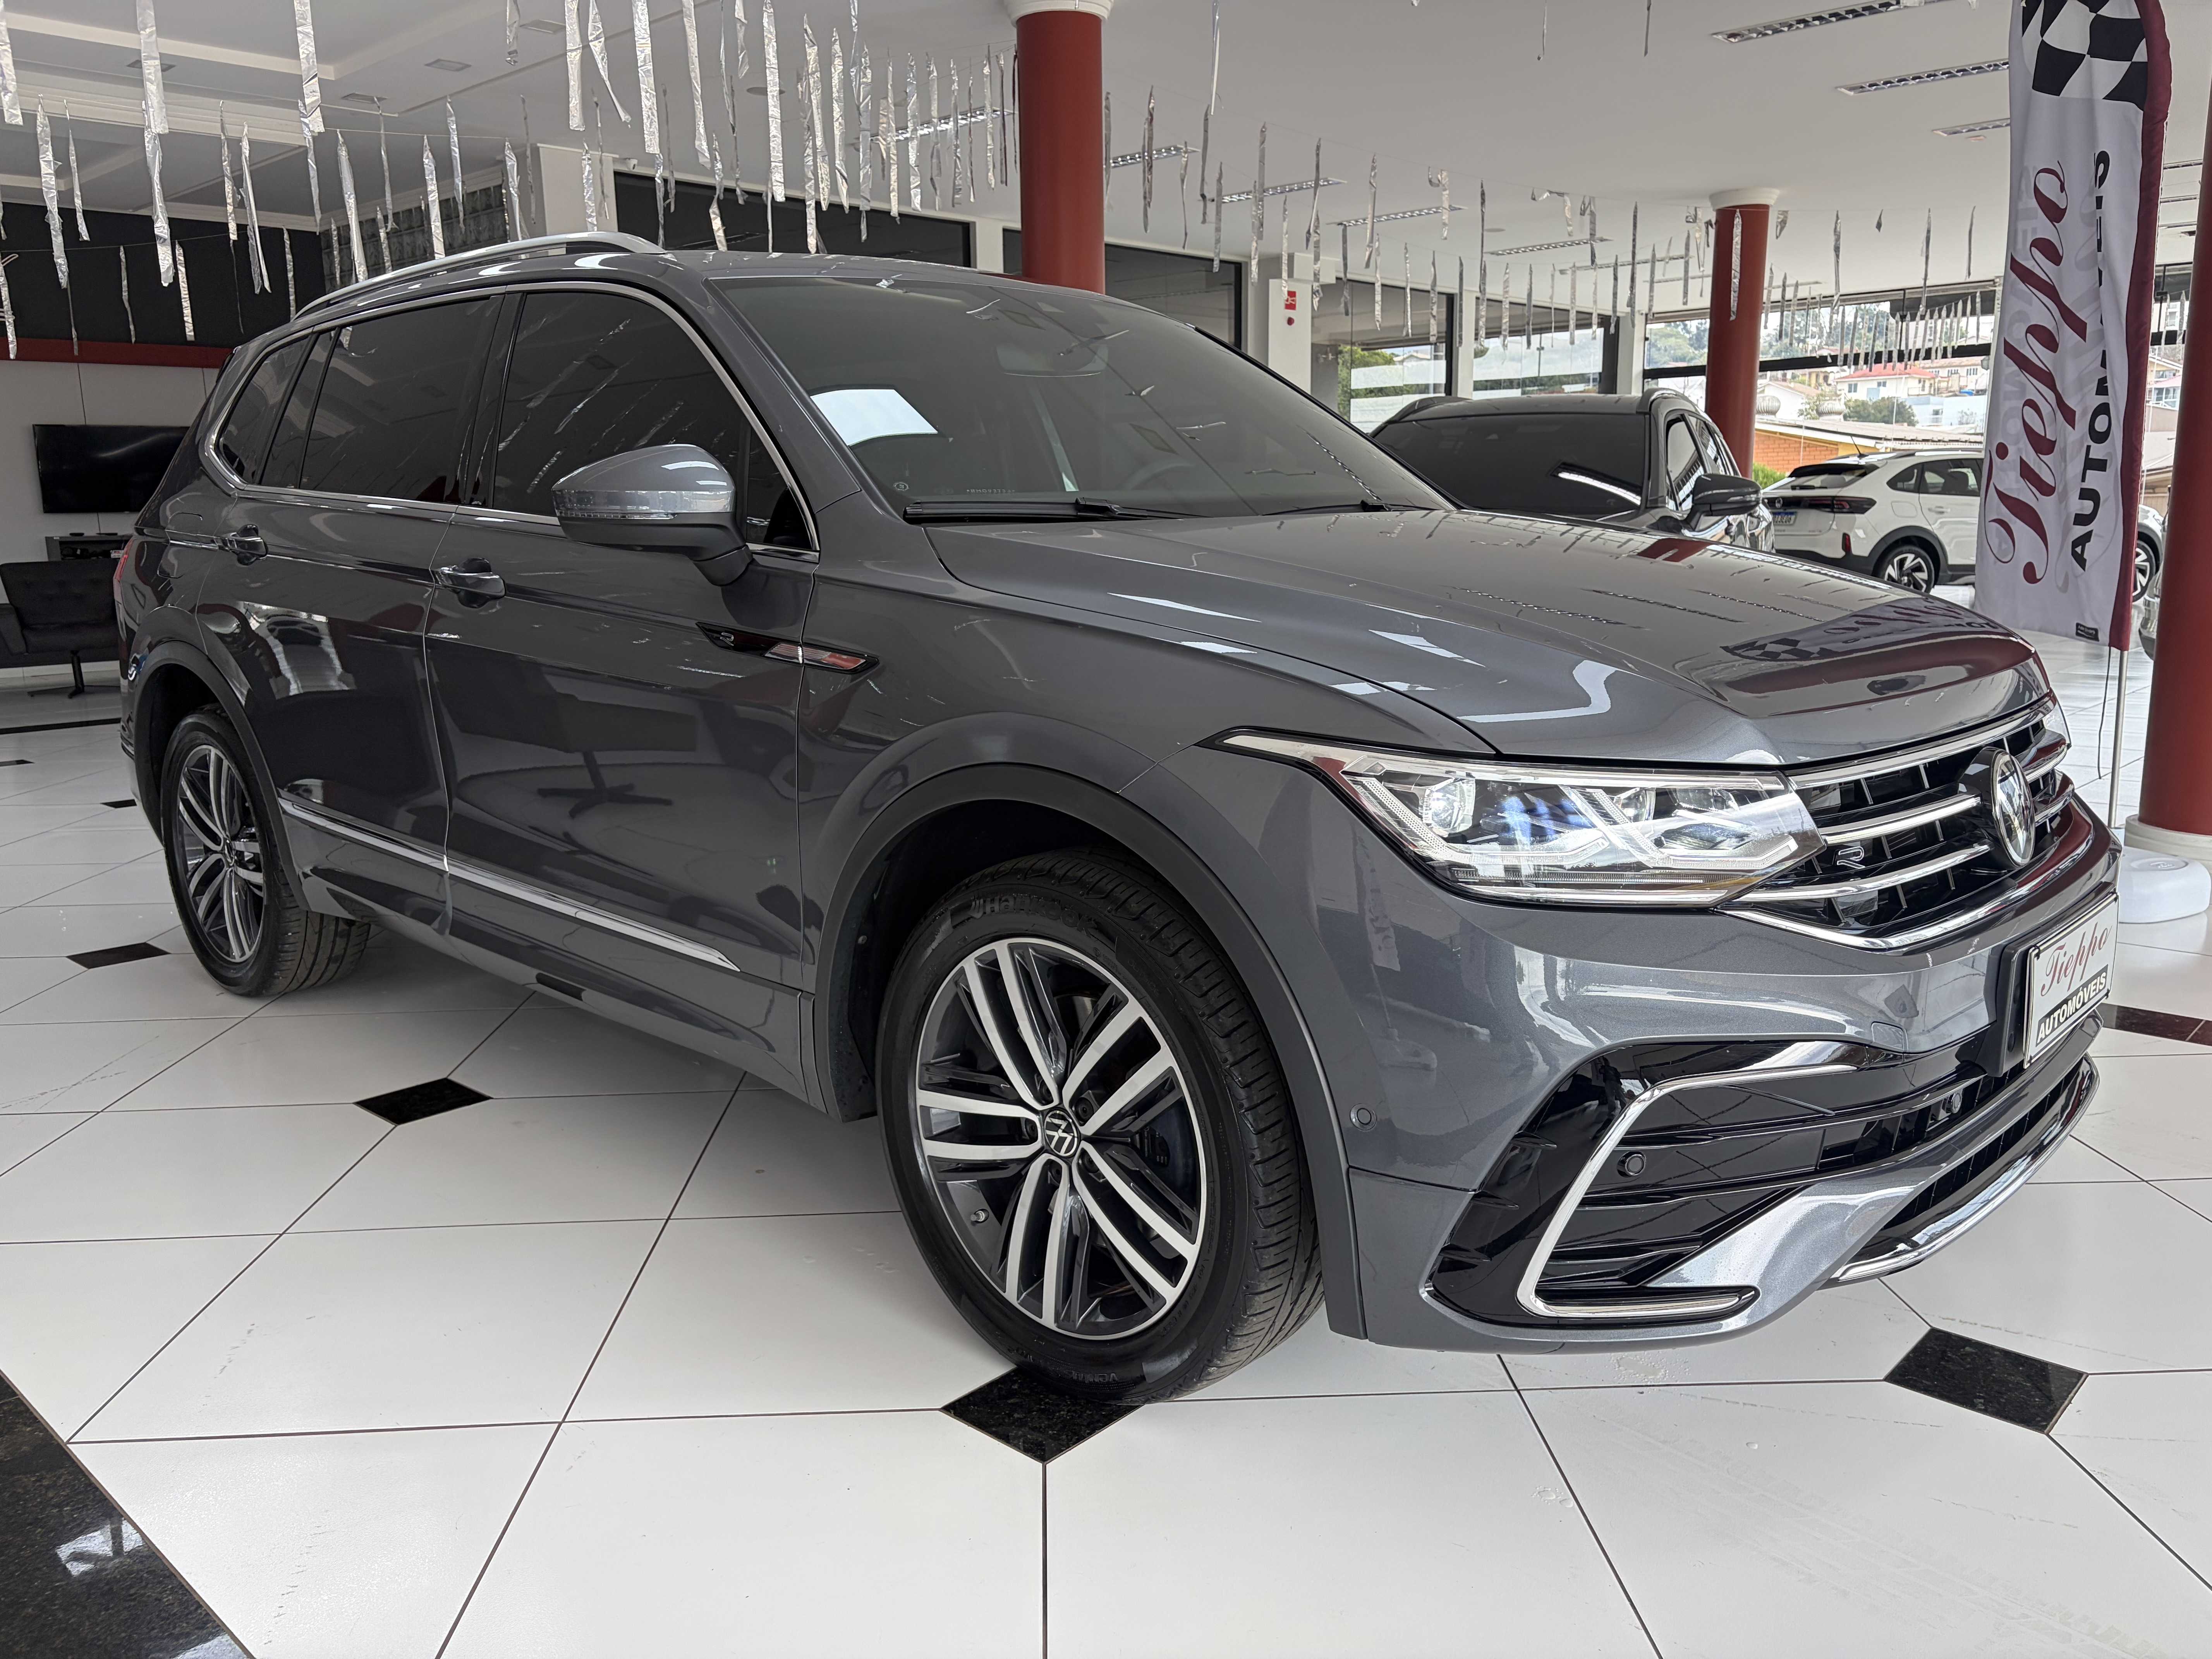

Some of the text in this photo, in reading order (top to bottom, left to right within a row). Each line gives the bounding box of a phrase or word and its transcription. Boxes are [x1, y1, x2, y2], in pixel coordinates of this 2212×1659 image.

[1984, 160, 2087, 584] Tieppo
[720, 632, 734, 646] R
[1837, 846, 1865, 869] R
[2040, 921, 2112, 997] Tieppo
[2037, 972, 2106, 1044] AUTOMÓVEIS
